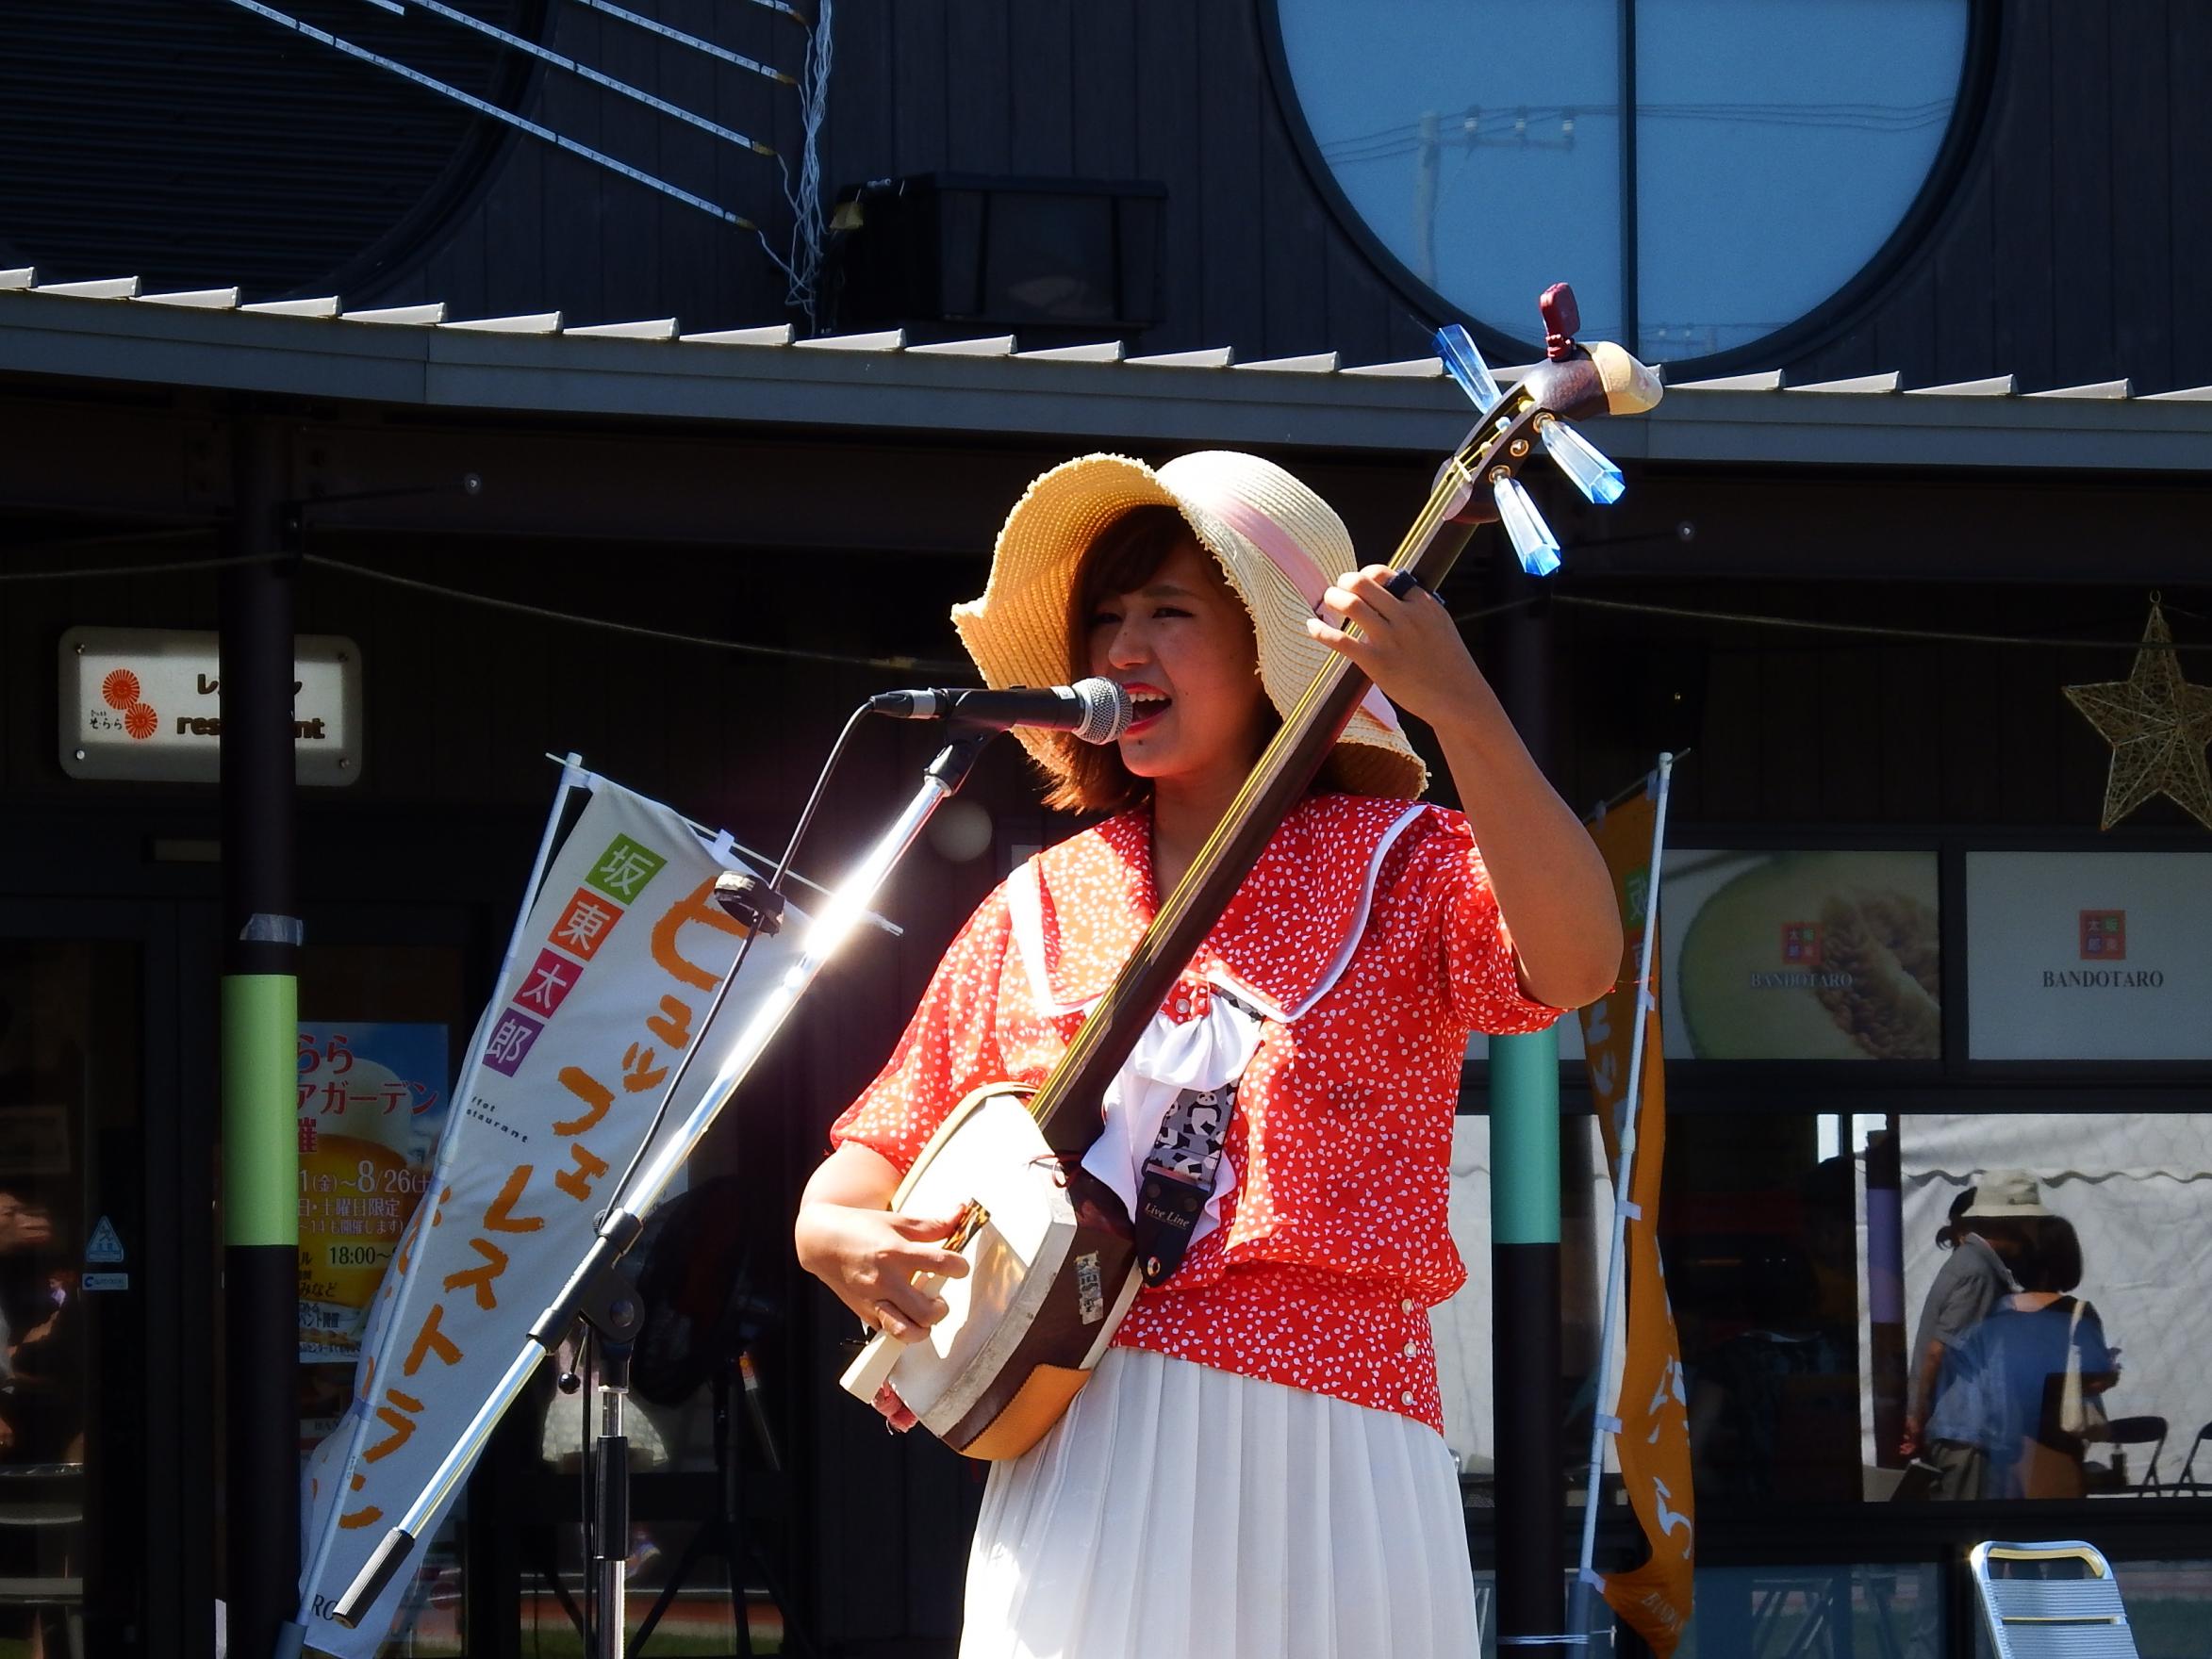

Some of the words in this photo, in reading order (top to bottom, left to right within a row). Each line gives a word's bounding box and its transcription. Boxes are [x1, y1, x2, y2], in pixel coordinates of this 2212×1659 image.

[485, 845, 655, 1064] 坂東太郎
[1750, 972, 1854, 988] BANDOTARO
[2042, 970, 2165, 988] BANDOTARO
[1146, 1203, 1165, 1218] Live
[1166, 1211, 1190, 1227] Line
